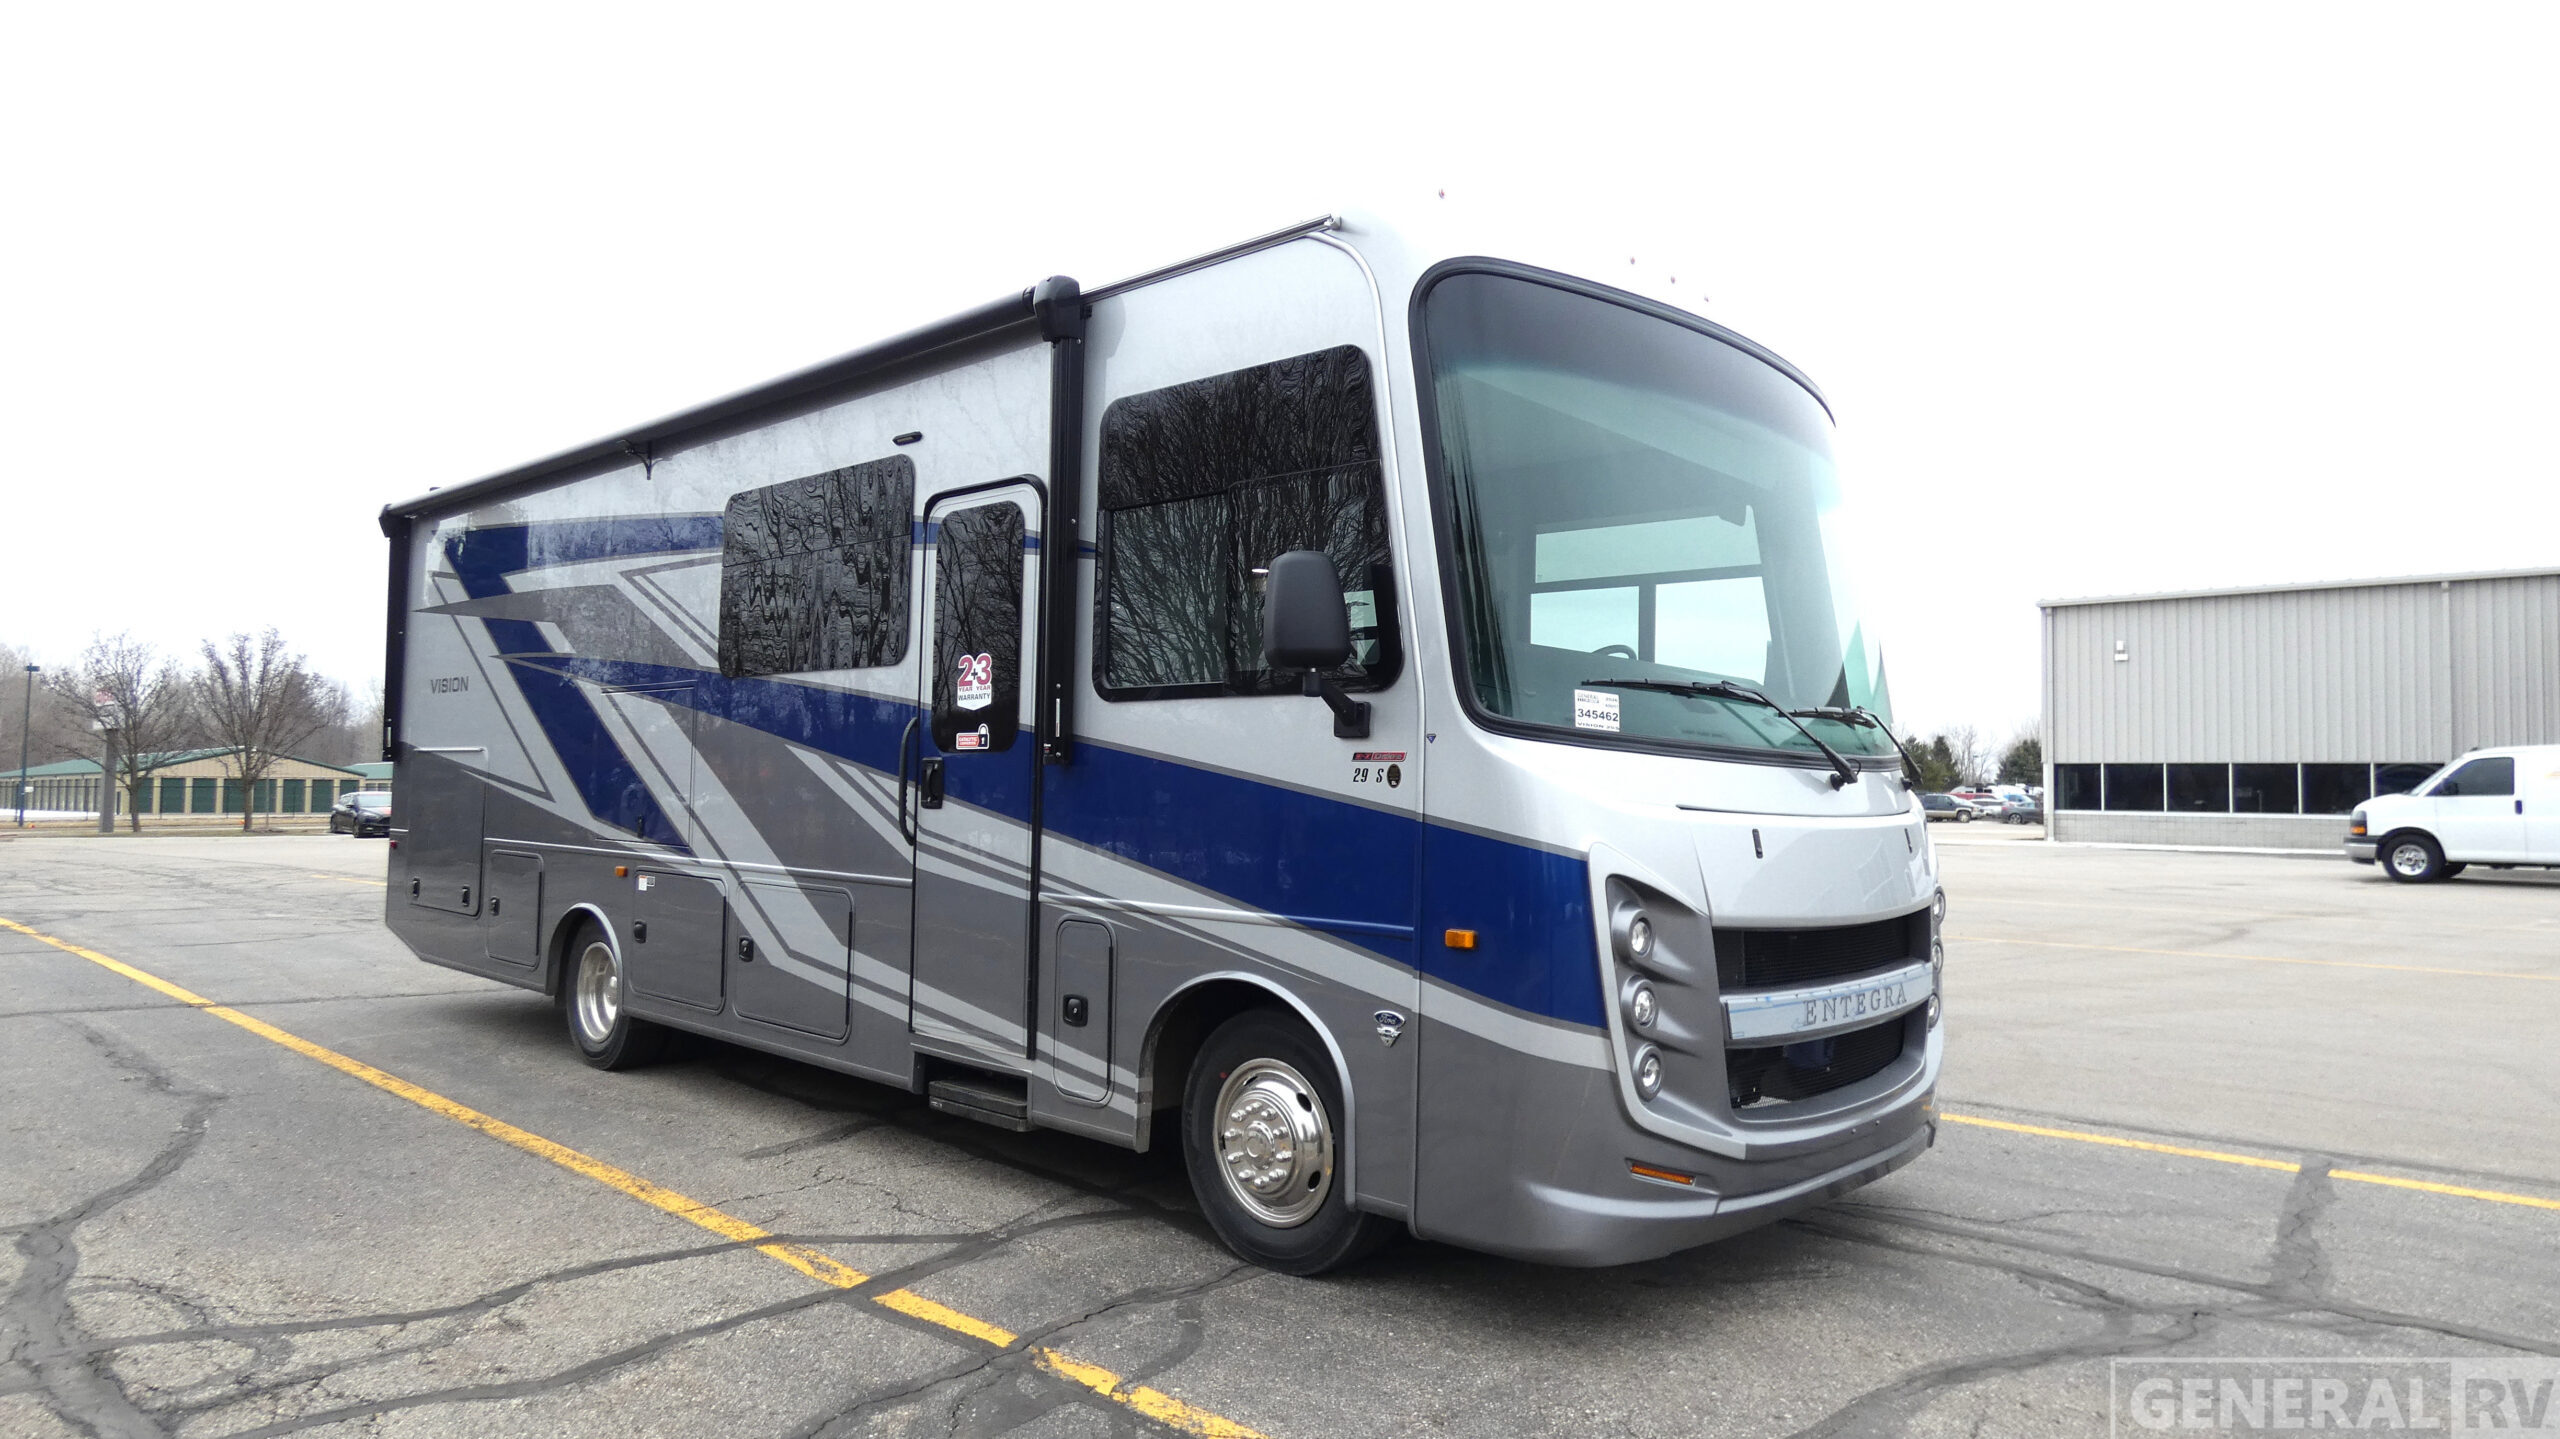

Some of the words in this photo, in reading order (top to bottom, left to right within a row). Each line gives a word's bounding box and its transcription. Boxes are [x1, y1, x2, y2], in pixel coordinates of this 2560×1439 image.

[430, 675, 469, 694] VISION
[958, 693, 991, 701] WARRANTY
[1577, 708, 1619, 722] 345462
[1352, 767, 1369, 783] 29
[1802, 983, 1908, 1027] ENTEGRA
